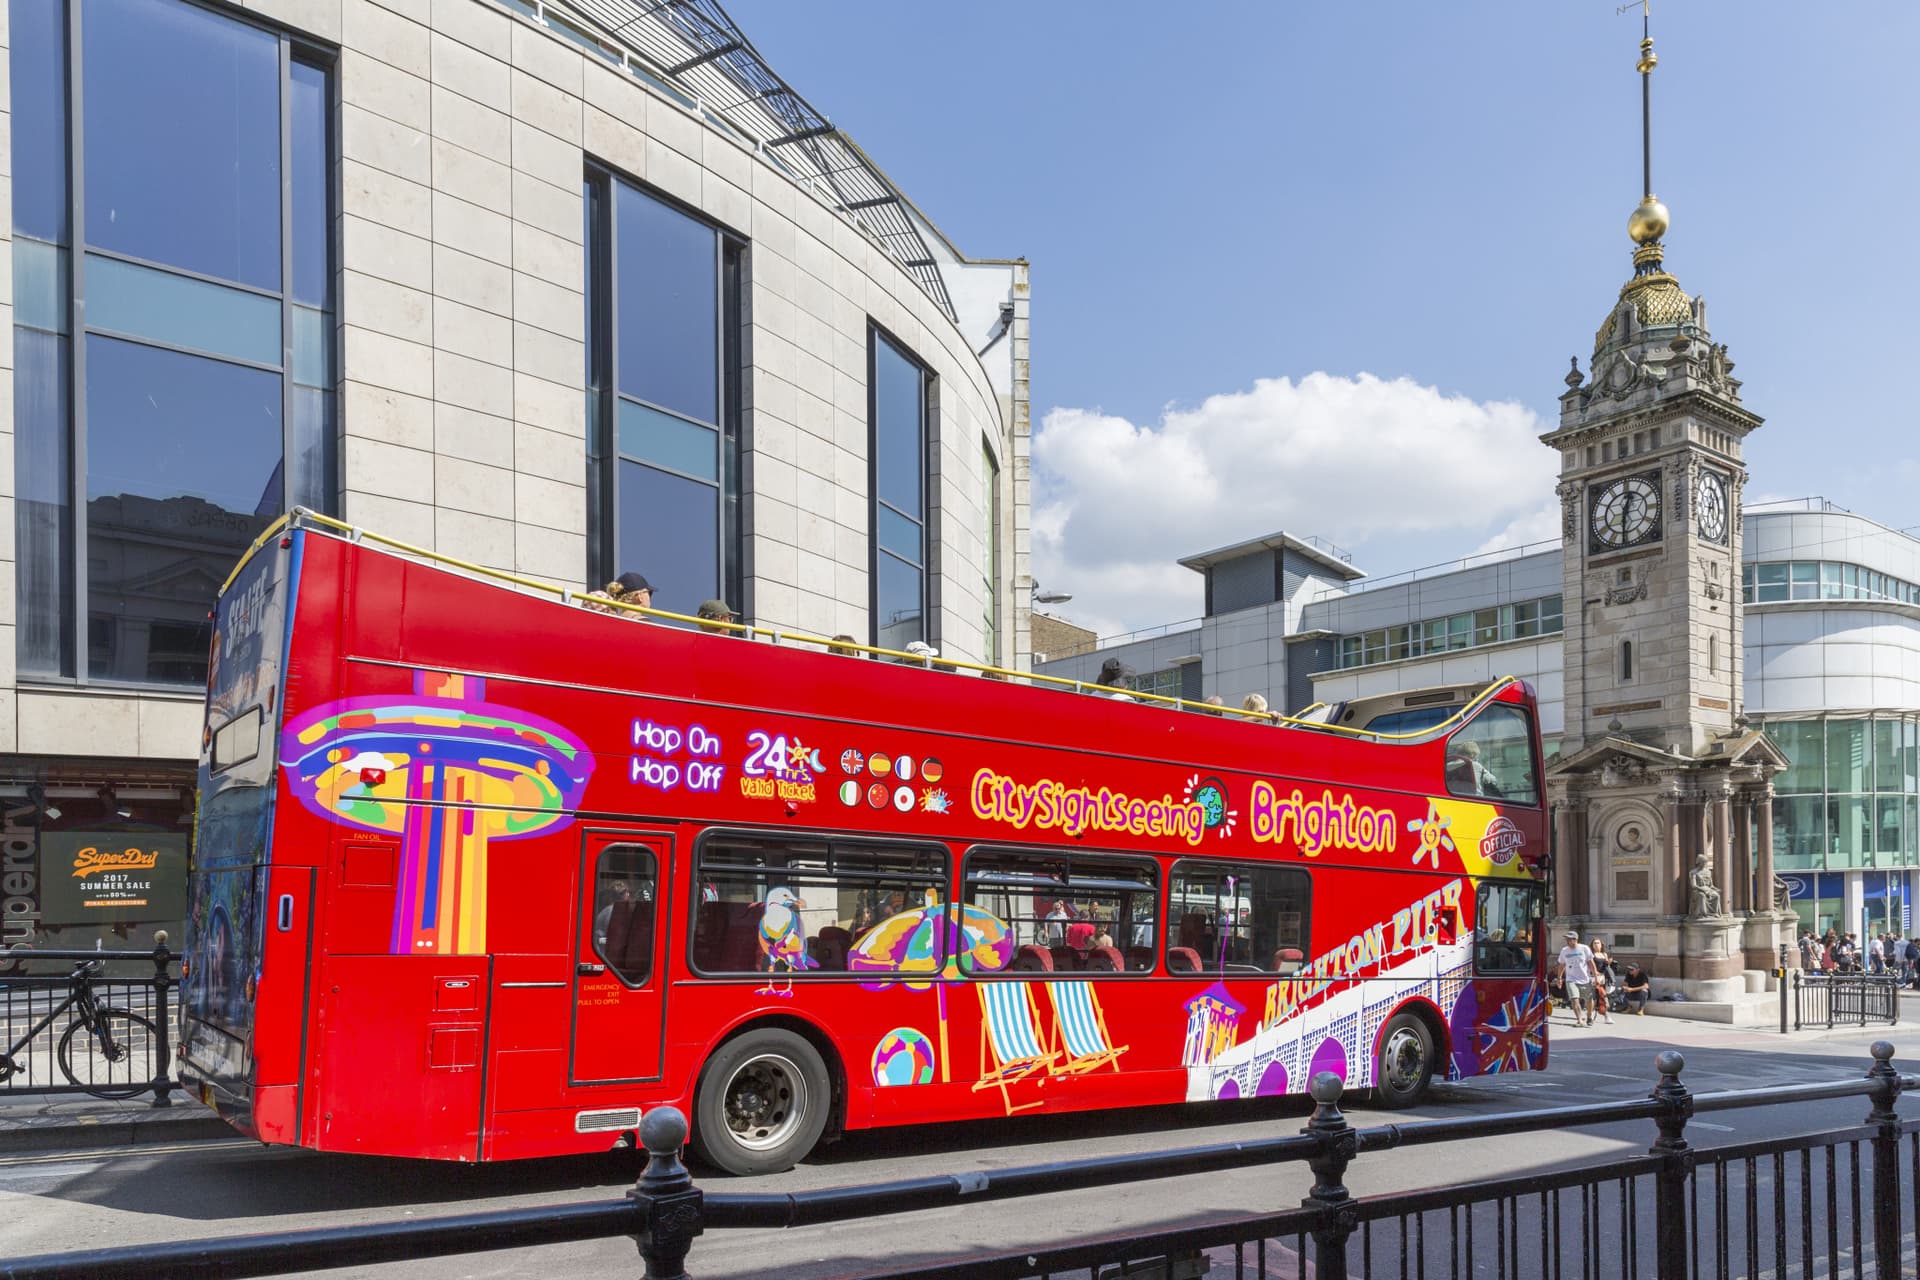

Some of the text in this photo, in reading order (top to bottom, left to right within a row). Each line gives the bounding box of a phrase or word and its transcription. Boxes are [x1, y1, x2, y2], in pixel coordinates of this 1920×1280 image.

[631, 718, 720, 757] Hop On
[743, 731, 788, 778] 24
[630, 755, 724, 792] Hop Off
[740, 777, 816, 801] Valid Ticket
[1250, 780, 1397, 858] Brighton
[1483, 832, 1523, 855] OFFICIAL
[1496, 850, 1514, 862] TOUR
[80, 881, 151, 890] SUMMER SALE
[103, 874, 129, 882] 2017
[1263, 879, 1468, 1032] BRIGHTON PIER
[583, 983, 620, 991] EMERGENCY
